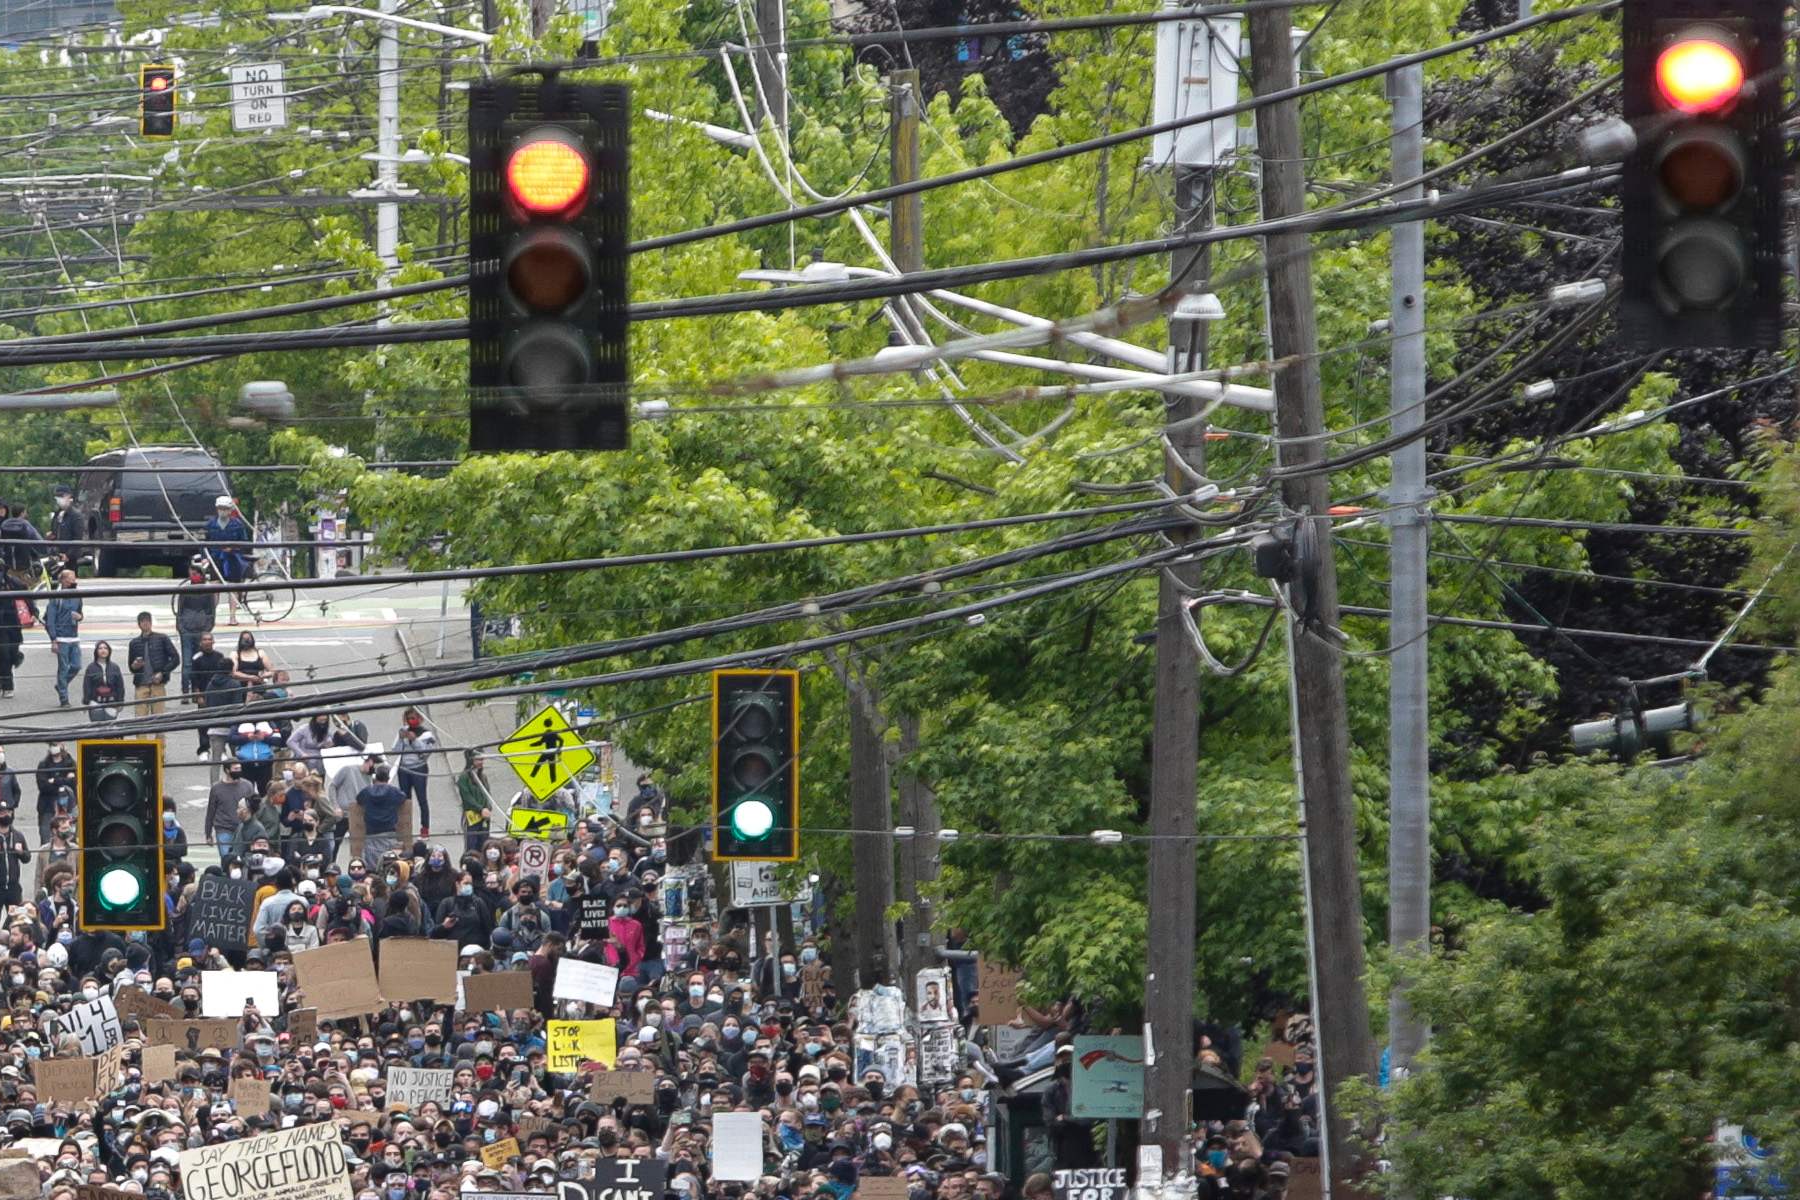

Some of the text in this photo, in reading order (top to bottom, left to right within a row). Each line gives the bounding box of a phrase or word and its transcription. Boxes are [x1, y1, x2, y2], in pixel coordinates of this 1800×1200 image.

[246, 69, 268, 83] NO
[243, 85, 273, 96] TURN
[251, 99, 267, 110] ON
[249, 112, 272, 124] RED
[201, 880, 246, 906] BLACK
[201, 904, 247, 923] LIVES
[191, 920, 247, 943] MATTER
[553, 1025, 581, 1038] STOP
[392, 1070, 452, 1086] NO JUSTICE
[390, 1089, 408, 1102] NO
[193, 1121, 339, 1167] SAY THEIR NAMES
[616, 1159, 641, 1183] I
[1054, 1167, 1128, 1189] JUSTICE
